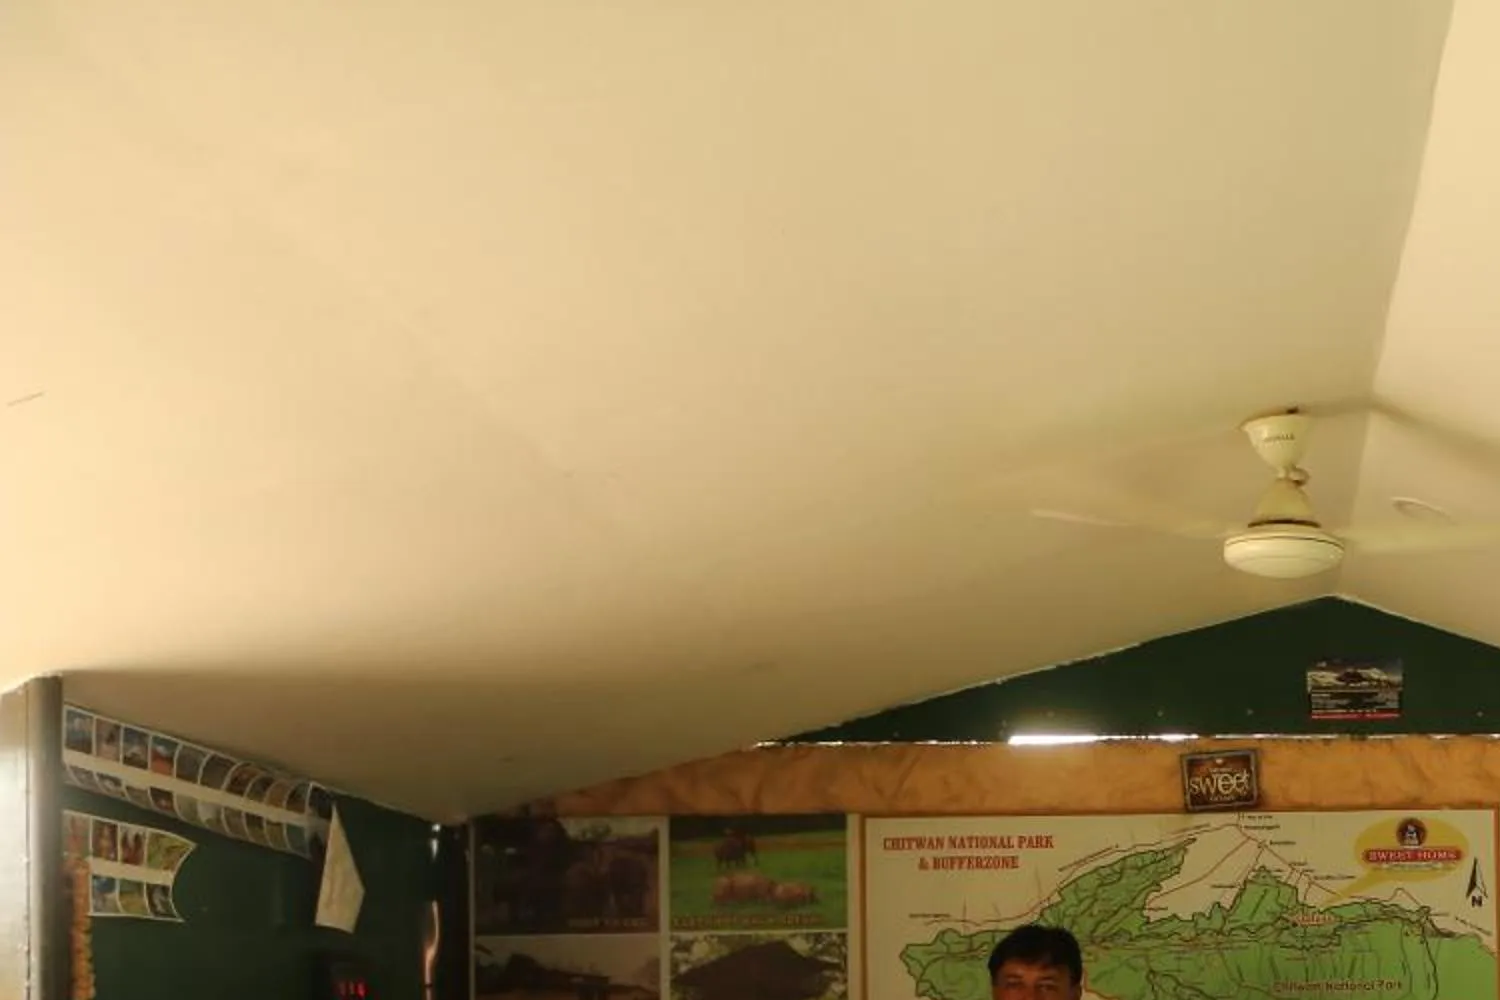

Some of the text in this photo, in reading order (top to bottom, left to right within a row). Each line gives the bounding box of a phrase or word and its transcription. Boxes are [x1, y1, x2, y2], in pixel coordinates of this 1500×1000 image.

[883, 835, 1054, 850] CHITWAN NATIONAL PARK
[933, 856, 1019, 870] BUFFERZONE
